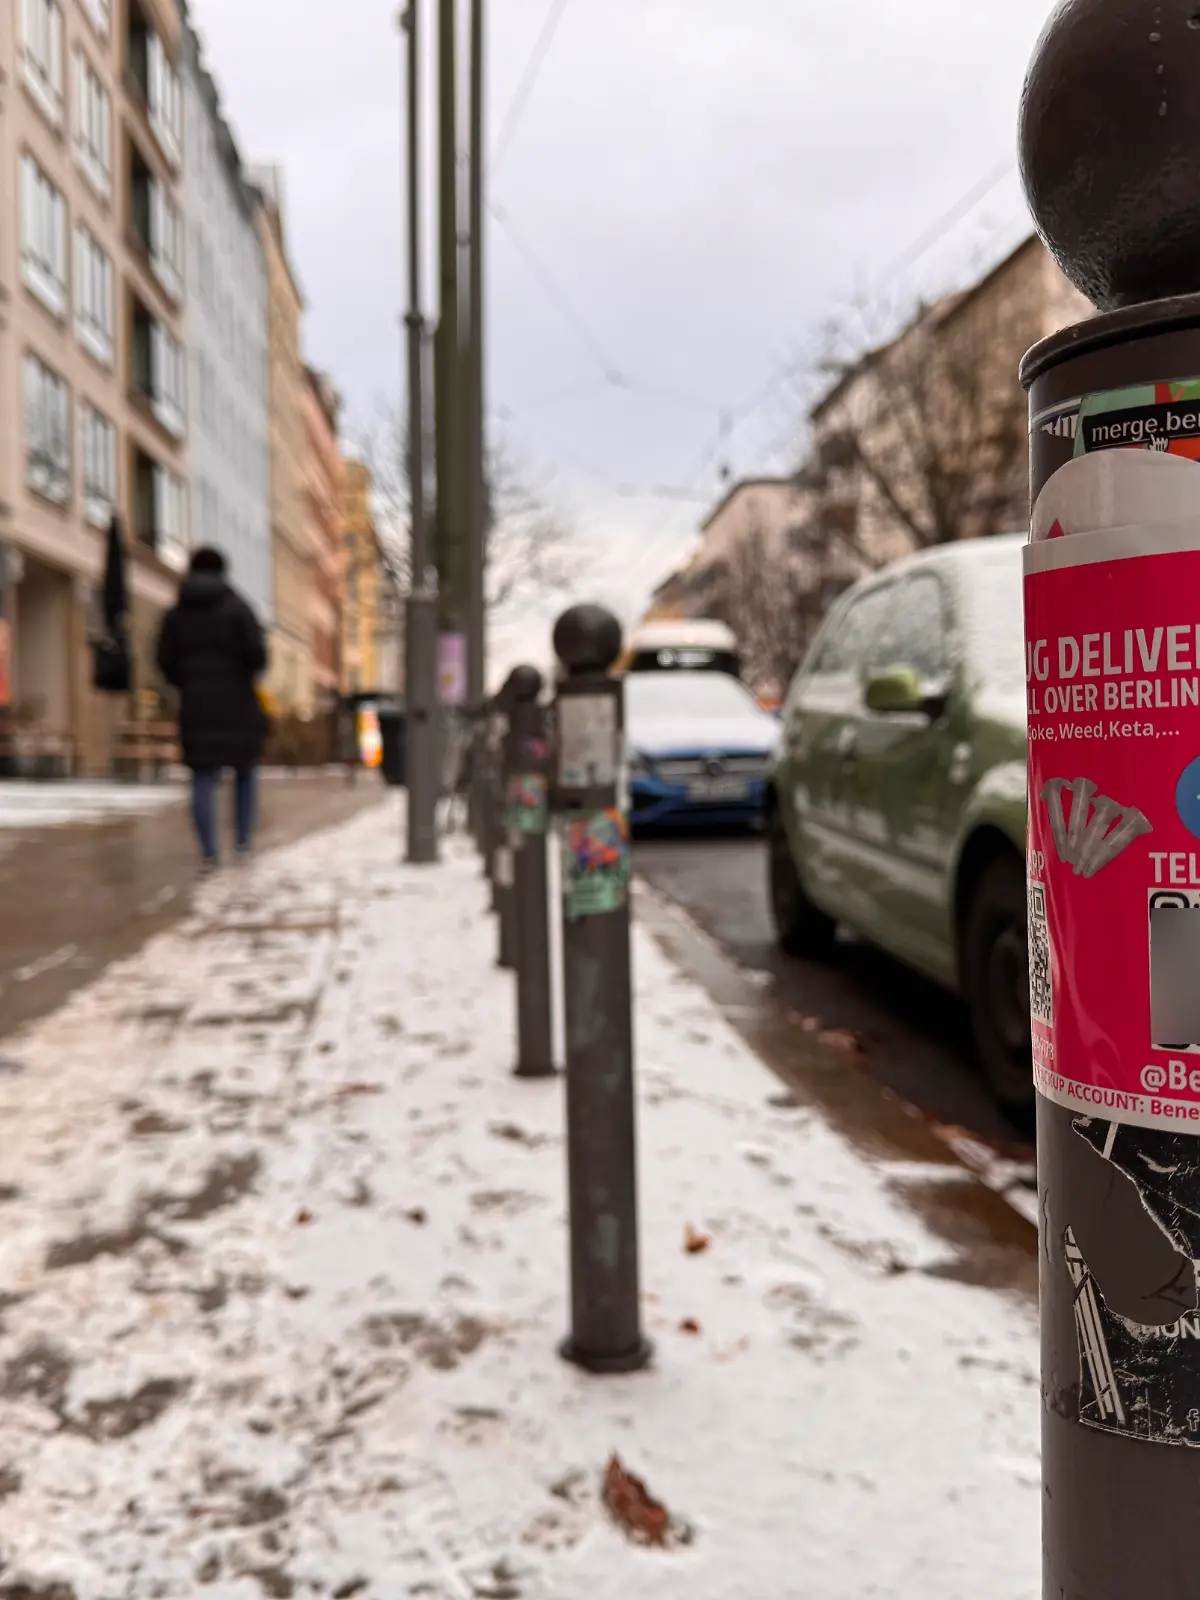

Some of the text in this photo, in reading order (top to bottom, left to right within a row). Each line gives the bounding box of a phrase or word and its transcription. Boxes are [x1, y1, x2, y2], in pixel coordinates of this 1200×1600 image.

[1092, 411, 1200, 442] merge.be
[1058, 624, 1200, 679] DELIVE
[1044, 683, 1098, 714] OVER
[1104, 677, 1199, 710] BERLIN
[1148, 852, 1200, 884] TEL
[1140, 1060, 1200, 1093] @Be
[1067, 1081, 1144, 1113] ACCOUNT:
[1151, 1099, 1200, 1120] Bene
